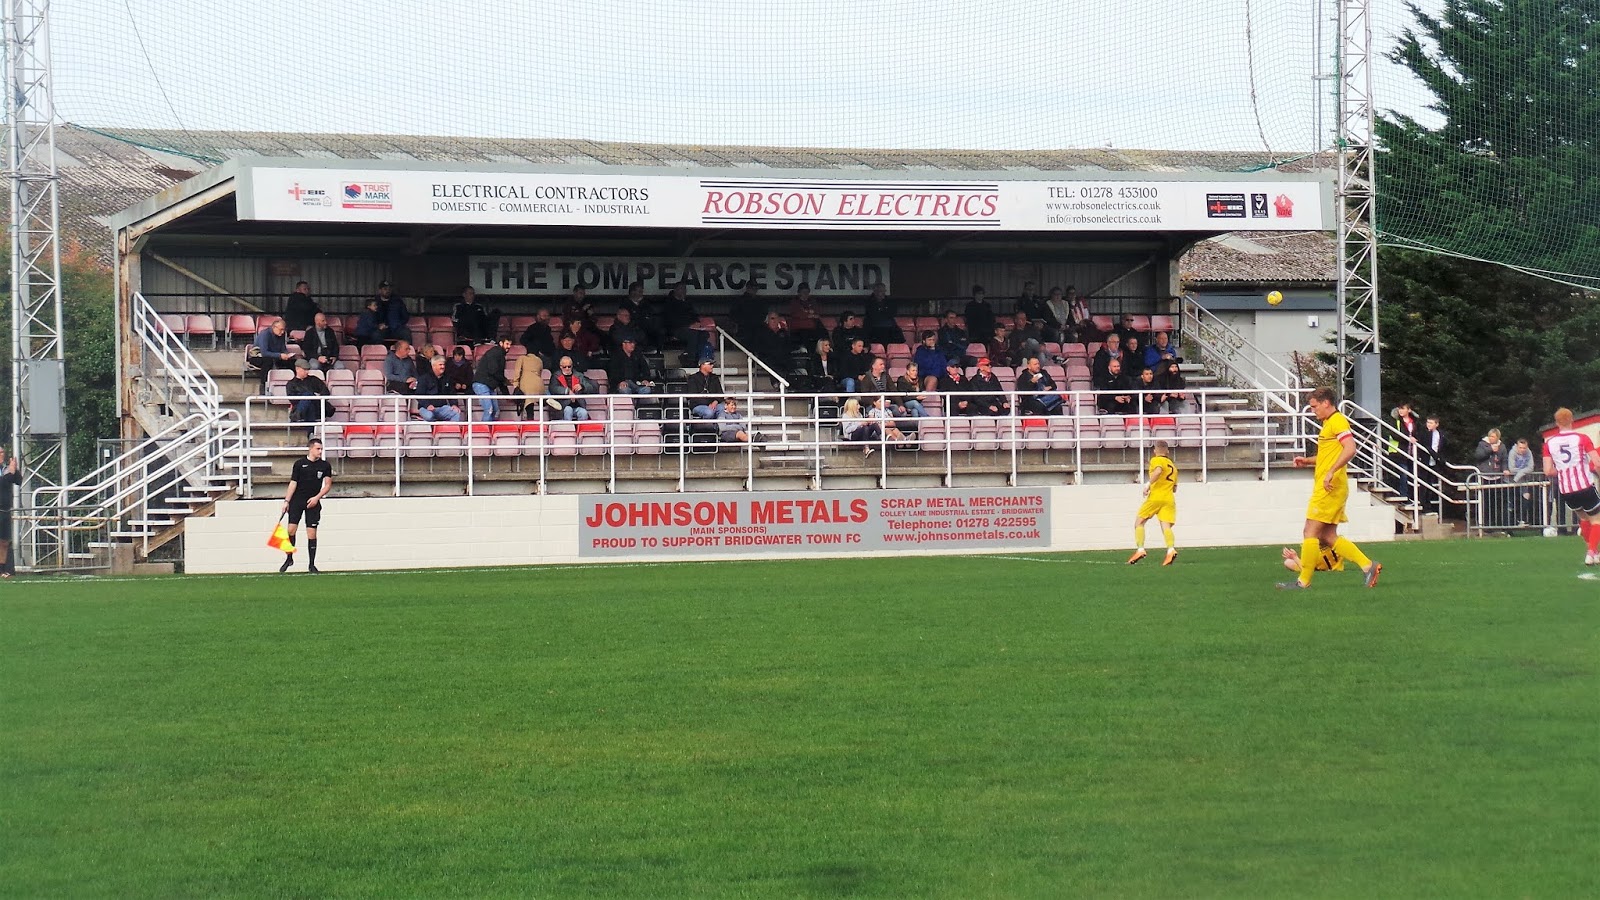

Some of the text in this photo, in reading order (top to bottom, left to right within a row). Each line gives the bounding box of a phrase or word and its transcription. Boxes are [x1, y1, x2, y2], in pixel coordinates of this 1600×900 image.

[365, 192, 390, 200] MARK
[432, 184, 649, 201] ELECTRICAL CONTRACTORS
[1047, 186, 1158, 199] TEL: 01278 433100
[432, 202, 488, 212] DOMESTIC
[499, 203, 573, 213] COMMERCIAL
[584, 204, 650, 214] INDUSTRIAL
[702, 191, 999, 217] ROBSON ELECTRICS
[1046, 201, 1162, 211] www.robsonelectrics.co.uk
[1046, 213, 1162, 225] info@robsonelectrics.co.uk
[478, 261, 884, 290] THE TOM PEARCE STAND
[1559, 444, 1572, 463] 5
[1165, 464, 1174, 482] 2
[881, 495, 1043, 509] SCRAP METAL MERCHANTS
[586, 498, 869, 528] JOHNSON METALS
[908, 509, 927, 517] LANE
[1001, 507, 1044, 515] BRIDGWATER
[690, 525, 767, 536] (MAIN SPONSORS)
[887, 516, 1037, 531] Telephone: 01278 422595
[592, 532, 861, 548] PROUD TO SUPPORT BRIDGWATER TOWN FC
[883, 528, 1041, 544] www.johnsonmetals.co.uk
